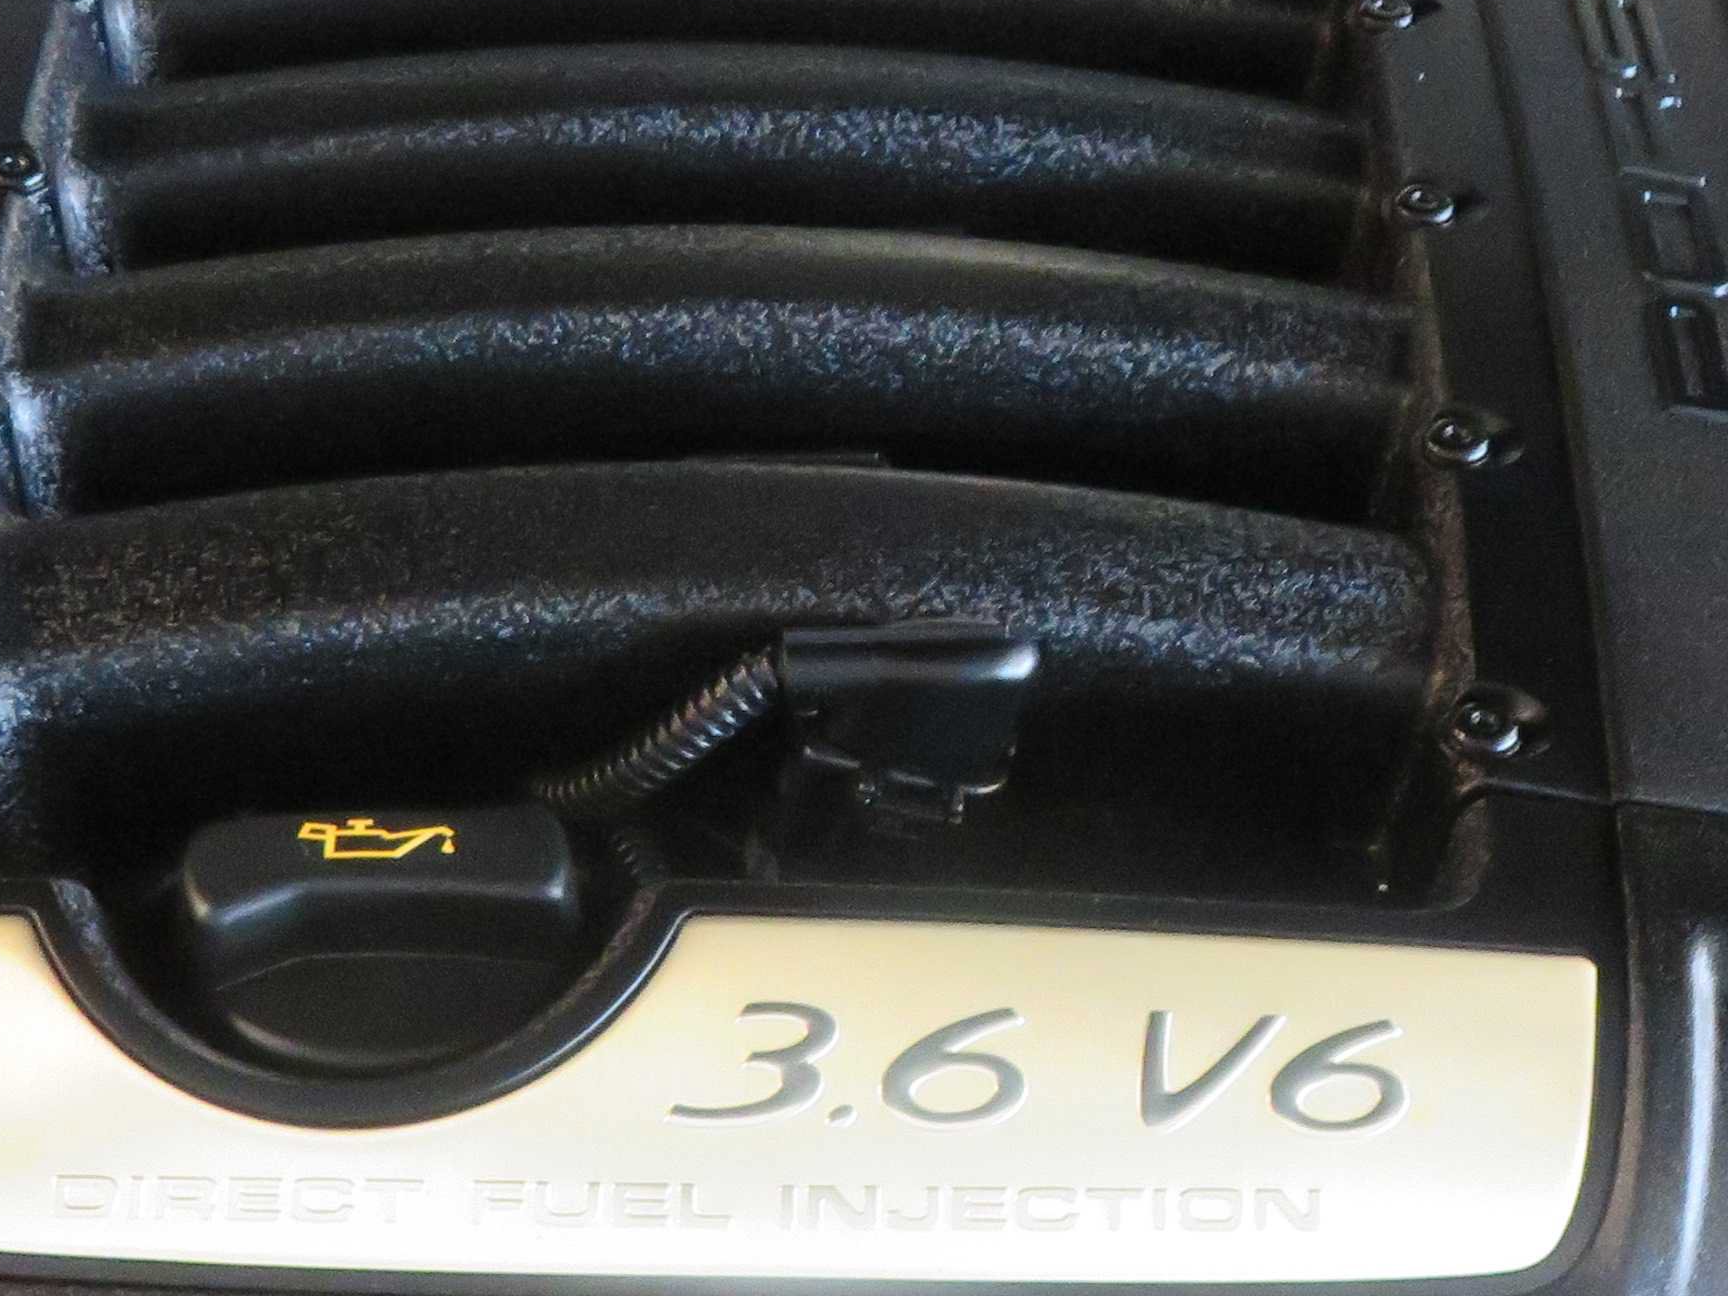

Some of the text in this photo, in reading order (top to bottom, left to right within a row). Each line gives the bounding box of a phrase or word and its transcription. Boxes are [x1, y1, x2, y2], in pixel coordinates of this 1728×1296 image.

[669, 1001, 1408, 1134] 3.6 V6
[51, 1171, 1325, 1233] DIRECT FUEL INJECTION
